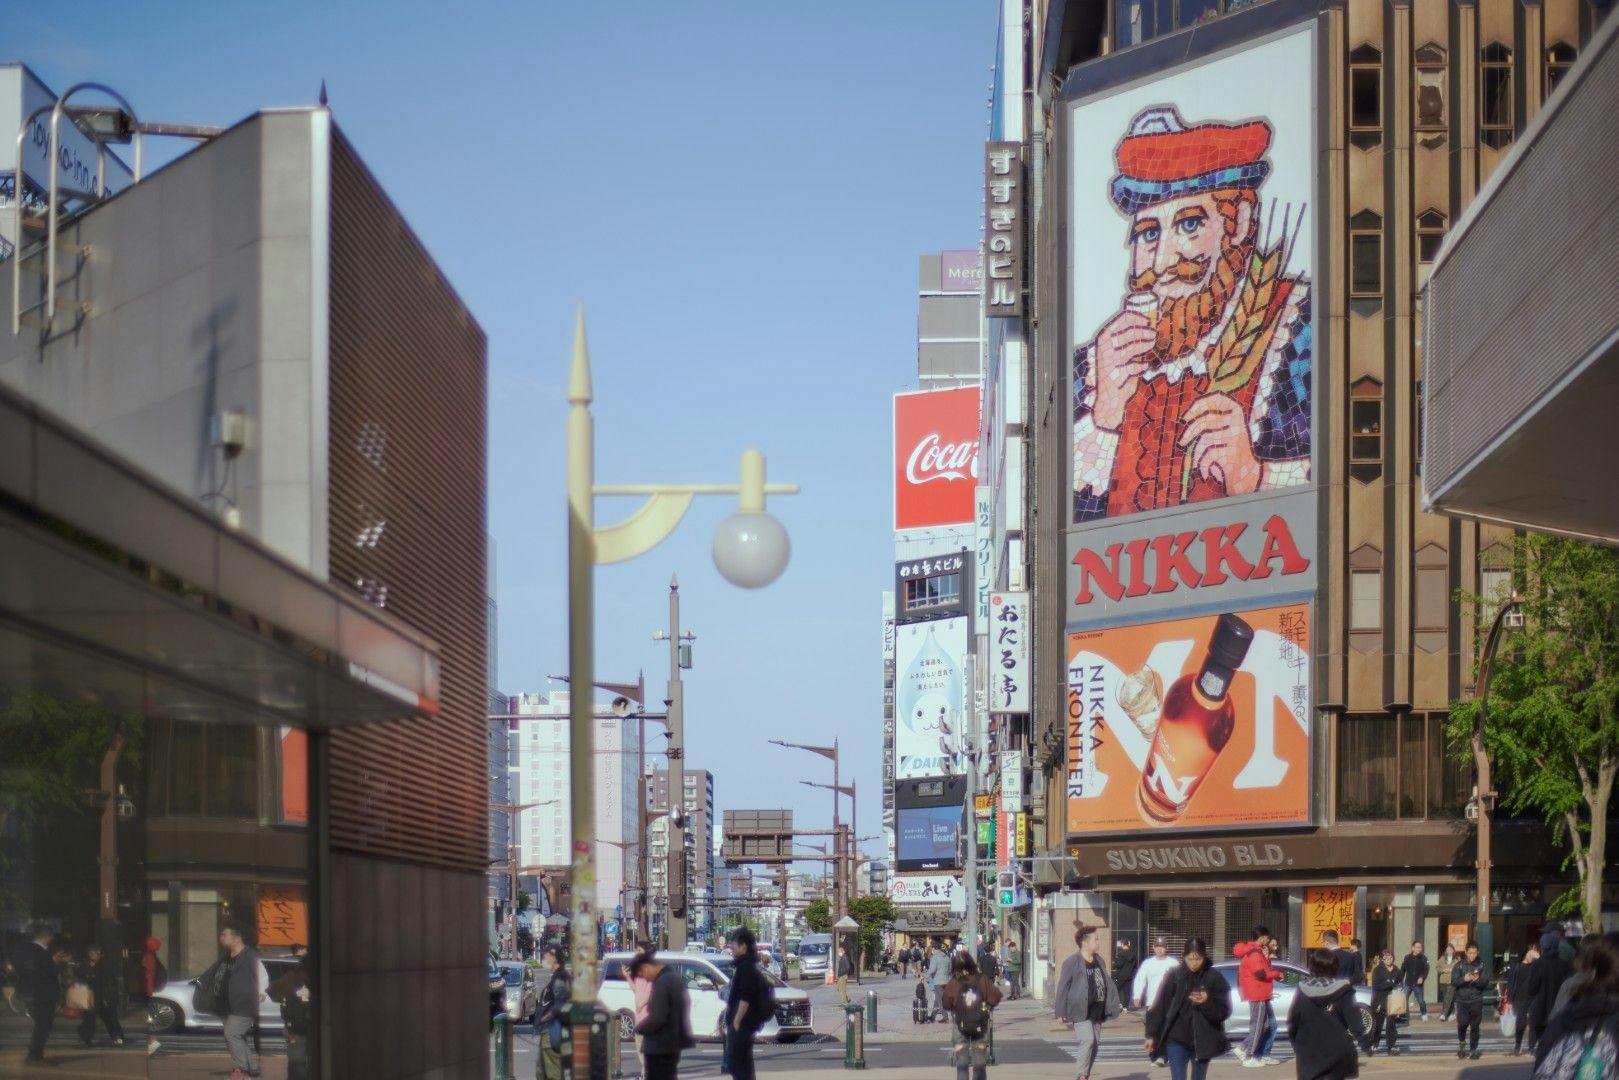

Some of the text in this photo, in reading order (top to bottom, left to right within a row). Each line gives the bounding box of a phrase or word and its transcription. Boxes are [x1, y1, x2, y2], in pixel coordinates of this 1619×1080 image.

[989, 149, 1016, 305] すすきのビル
[1072, 514, 1310, 605] NIKKA
[1068, 667, 1084, 799] FRONTIER
[1089, 664, 1105, 752] NIKKA
[1106, 844, 1294, 871] SUSUKINO BLD.
[1312, 892, 1327, 944] スクエア
